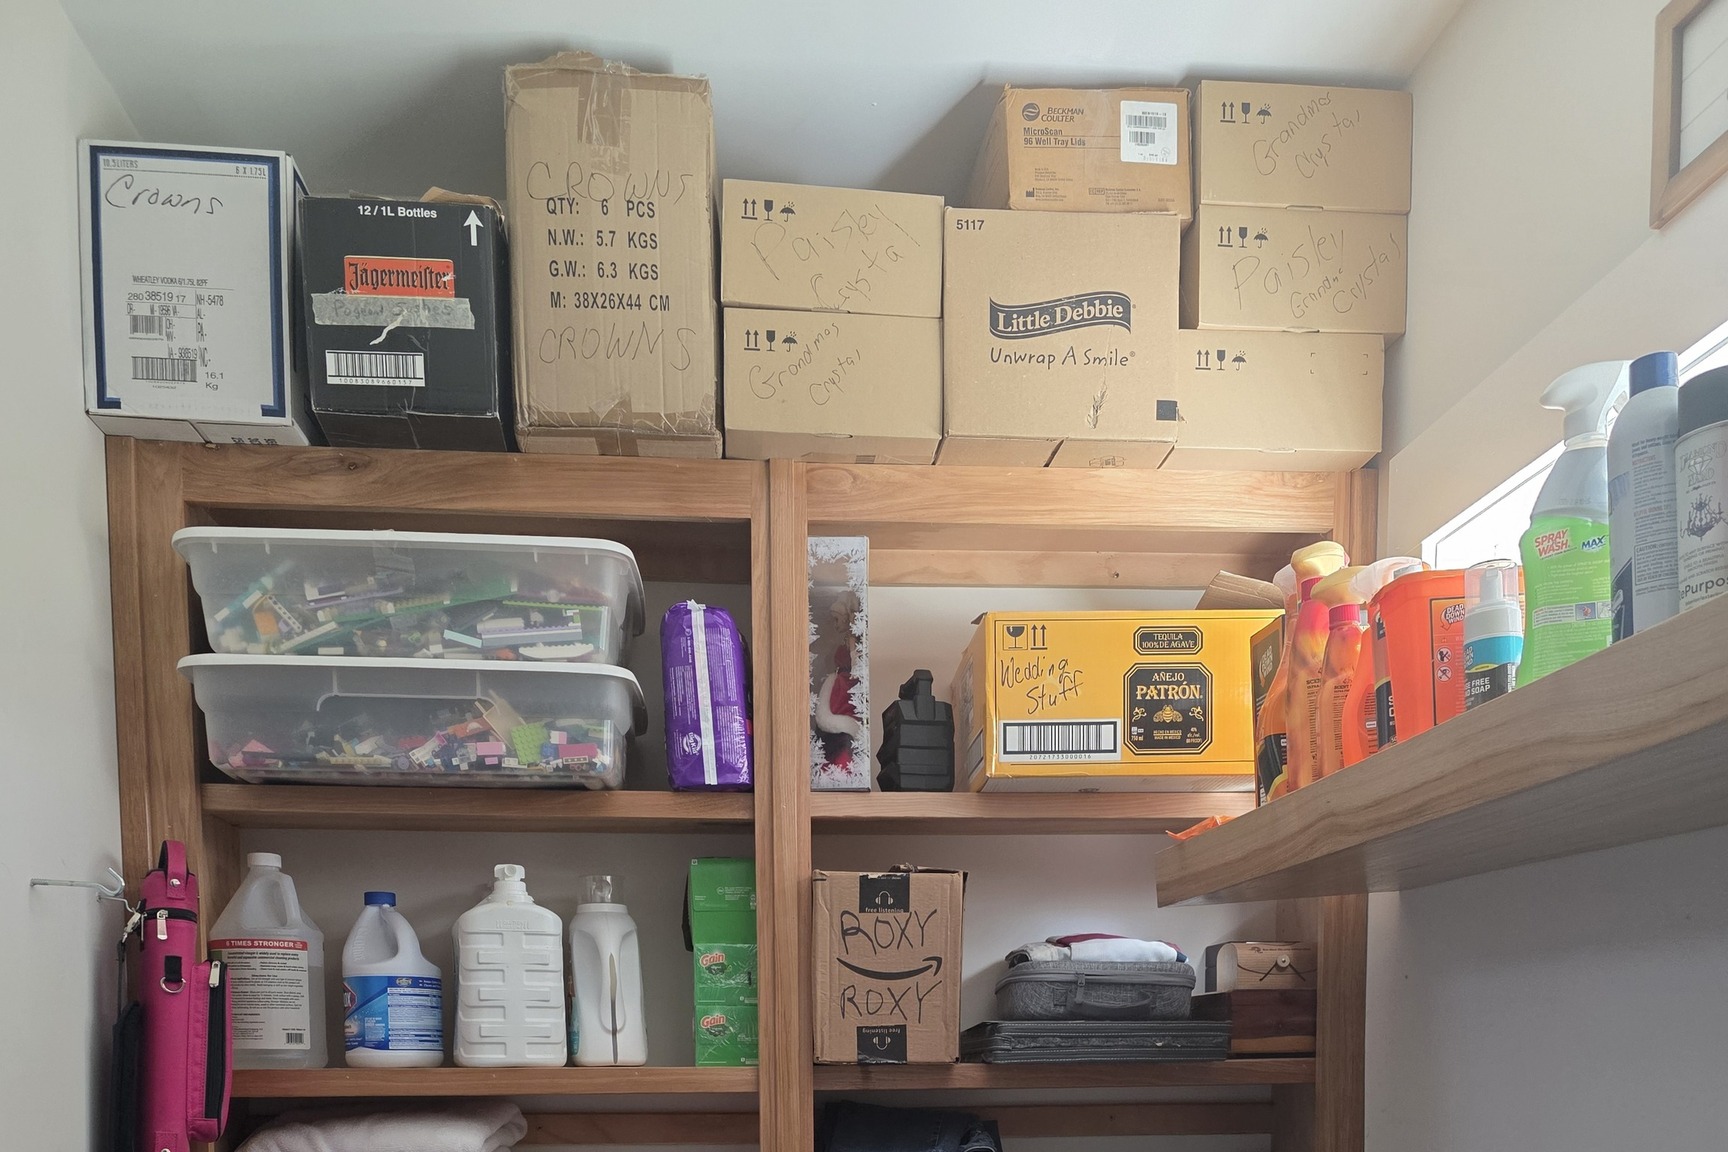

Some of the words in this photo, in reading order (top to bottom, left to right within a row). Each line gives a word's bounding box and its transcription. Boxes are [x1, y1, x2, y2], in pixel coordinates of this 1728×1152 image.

[1041, 114, 1075, 123] COULTER
[1047, 107, 1085, 116] BECKMAN
[1023, 127, 1063, 136] MicroScan
[1023, 137, 1033, 146] 96
[1034, 137, 1052, 146] Well
[1054, 137, 1069, 147] Tray
[1071, 137, 1086, 147] Lids
[526, 161, 694, 206] CROWNS
[105, 173, 223, 215] Crowns
[357, 205, 371, 215] 12
[373, 205, 378, 215] /
[381, 206, 395, 217] 1L
[397, 206, 438, 218] Bottles
[546, 198, 580, 215] QTY:
[601, 199, 609, 216] 6
[626, 200, 656, 218] PCS
[956, 219, 985, 231] 5117
[547, 229, 584, 246] N.W.:
[596, 230, 616, 247] 5.7
[627, 231, 658, 249] KGS
[549, 260, 586, 277] G.W.:
[597, 261, 617, 278] 6.3
[628, 263, 659, 280] KGS
[1232, 225, 1345, 310] Paisley
[132, 275, 159, 283] WHEATLEY
[160, 276, 178, 285] VODKA
[127, 293, 144, 301] 280
[144, 290, 174, 302] 38519
[176, 295, 186, 303] 17
[550, 291, 566, 308] M:
[574, 292, 641, 310] 38X26X44
[649, 295, 670, 312] CM
[997, 310, 1050, 332] Little
[1054, 299, 1123, 327] Debbie
[539, 321, 696, 371] CROWNS
[990, 347, 1056, 370] Unwrap
[1061, 345, 1077, 365] A
[1084, 348, 1129, 367] Smile
[205, 371, 224, 380] 16.1
[809, 349, 861, 406] Crystal
[205, 382, 219, 391] Kg
[1534, 528, 1568, 548] SPRAY
[1581, 535, 1606, 550] MAX
[1537, 539, 1569, 558] WASH
[1445, 609, 1465, 620] DOWN
[1446, 603, 1464, 614] DEAD
[1153, 633, 1183, 641] TEQUILA
[1170, 640, 1195, 648] AGAVE
[1000, 656, 1070, 690] Wedding
[1152, 671, 1185, 682] AÑEJO
[1471, 677, 1490, 687] FREE
[1471, 684, 1491, 695] SOAP
[1026, 669, 1085, 715] Stuff
[1136, 681, 1202, 700] PATRÓN
[840, 908, 938, 955] ROXY
[253, 940, 294, 948] STRONGER
[700, 952, 726, 967] Gain
[840, 980, 943, 1024] ROXY
[701, 1013, 727, 1029] Gain
